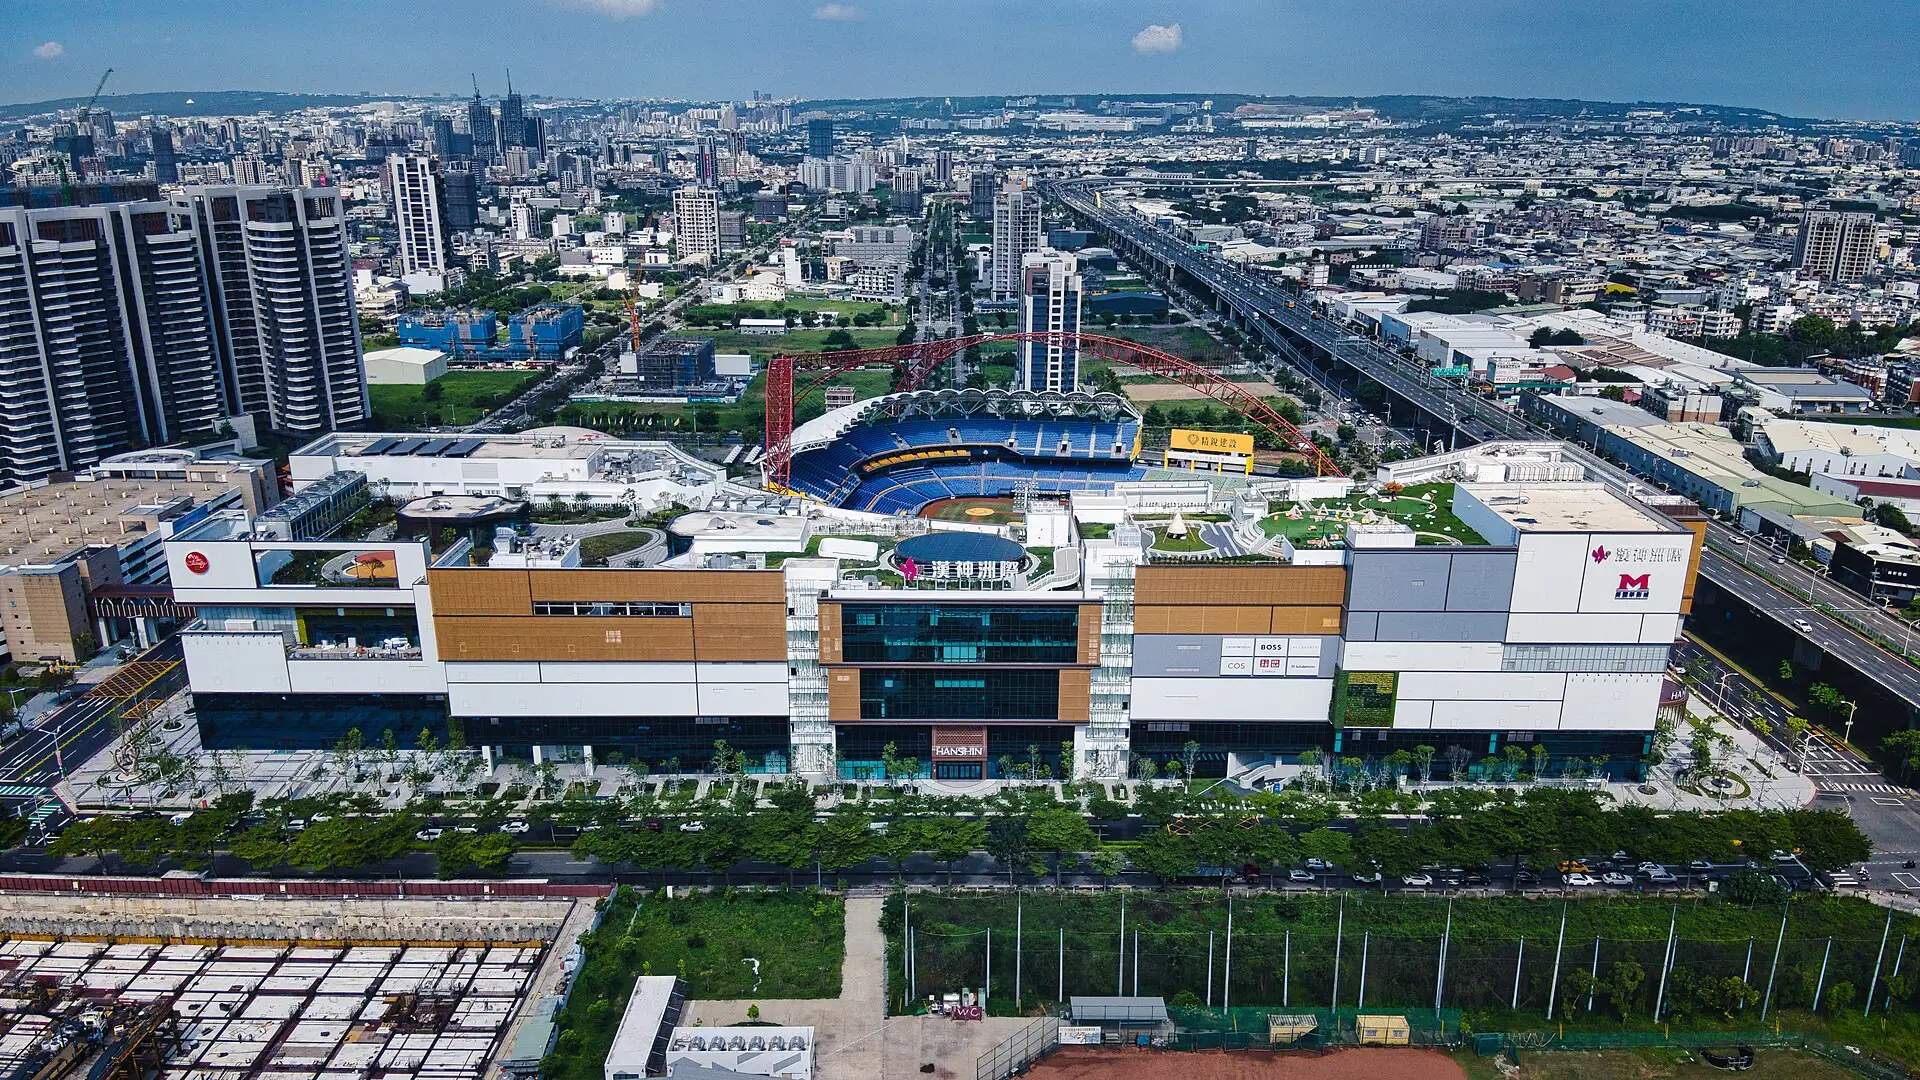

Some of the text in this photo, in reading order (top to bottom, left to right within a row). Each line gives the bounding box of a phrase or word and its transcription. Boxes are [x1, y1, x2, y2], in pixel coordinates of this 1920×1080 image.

[931, 560, 1019, 580] 漢神洲際
[1619, 573, 1651, 590] M
[936, 747, 983, 756] HANSHIN
[957, 1007, 979, 1017] WC
